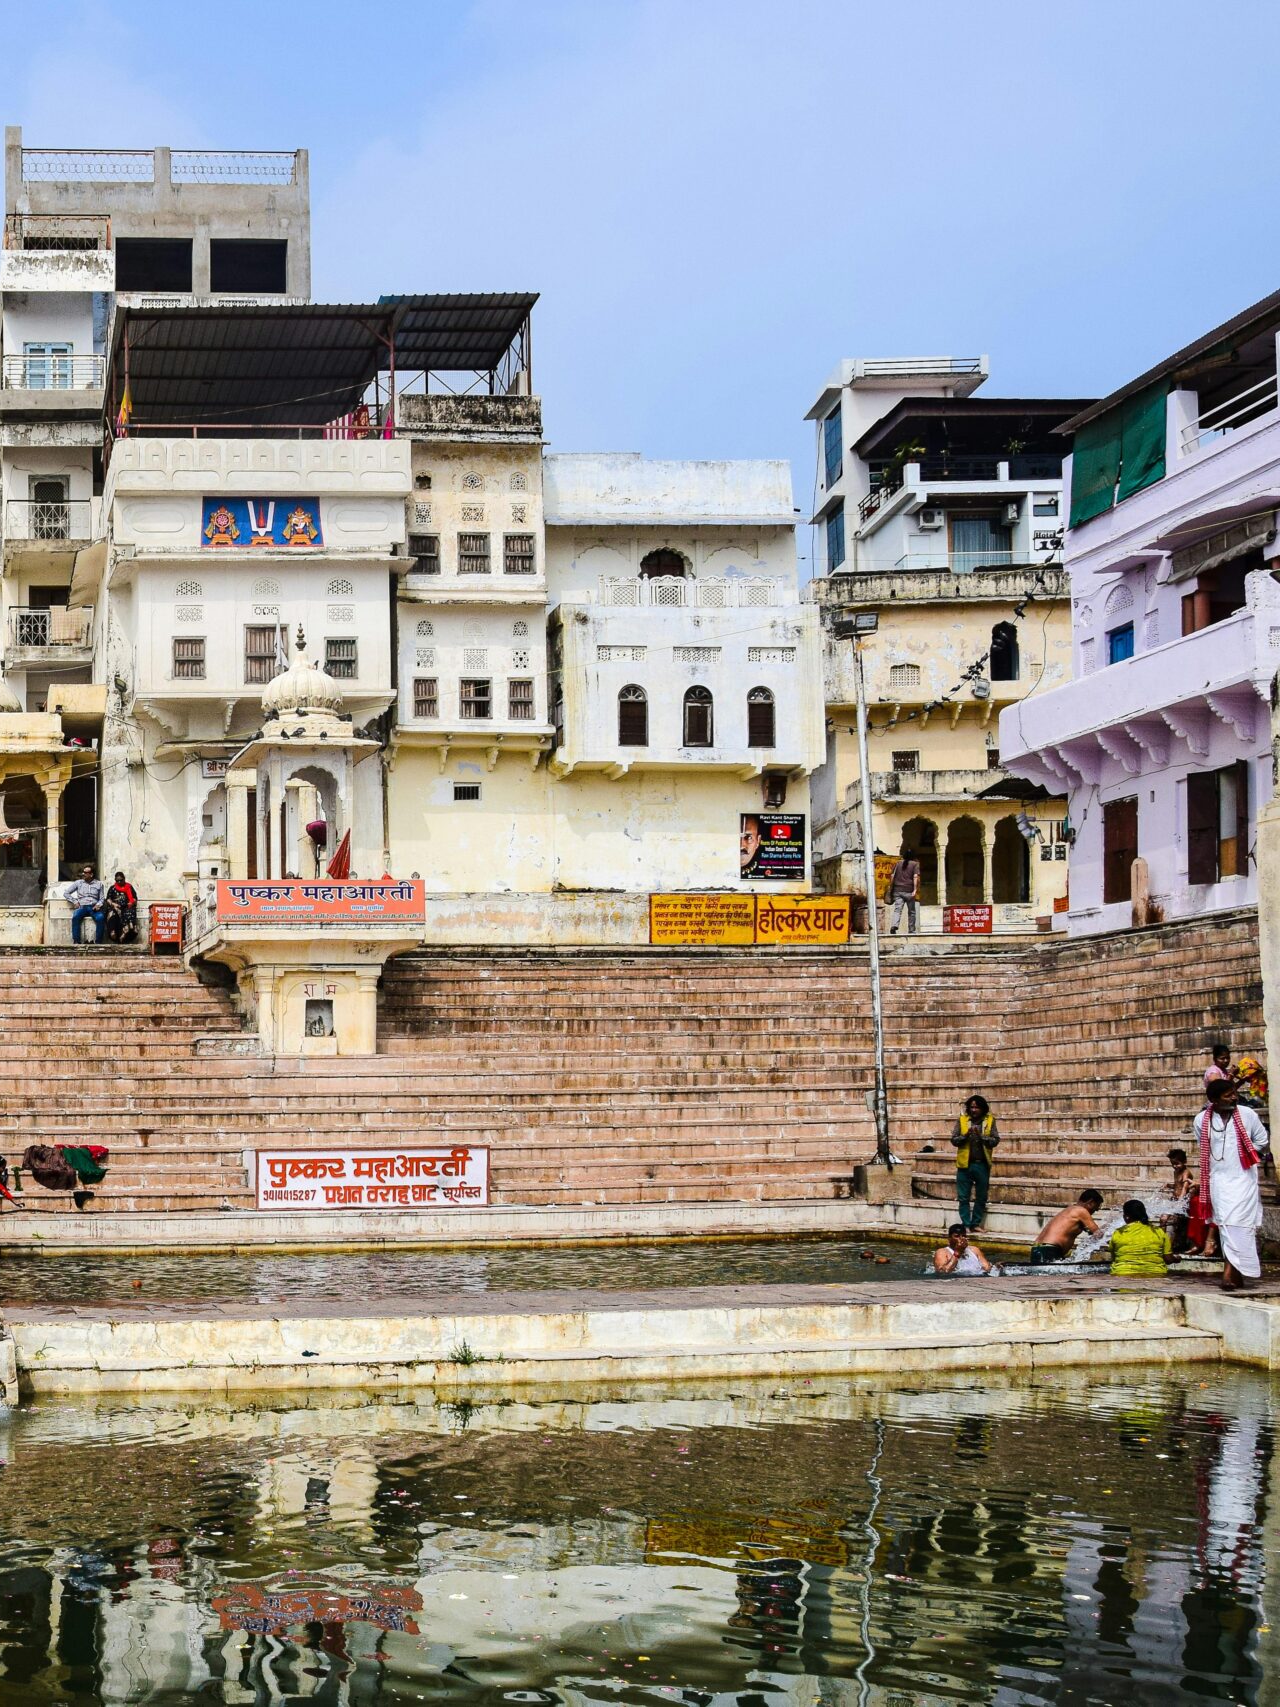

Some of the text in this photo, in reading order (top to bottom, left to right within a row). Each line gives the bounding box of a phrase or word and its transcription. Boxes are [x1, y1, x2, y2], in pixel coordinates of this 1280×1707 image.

[207, 761, 217, 771] श्री
[228, 881, 415, 906] पुष्कर महाआरती
[758, 901, 847, 934] होल्कर घाट
[267, 1148, 473, 1188] पुष्कर महाआरती
[366, 1185, 410, 1205] वराह
[412, 1184, 439, 1202] घाट
[442, 1181, 481, 1203] सूर्यास्त
